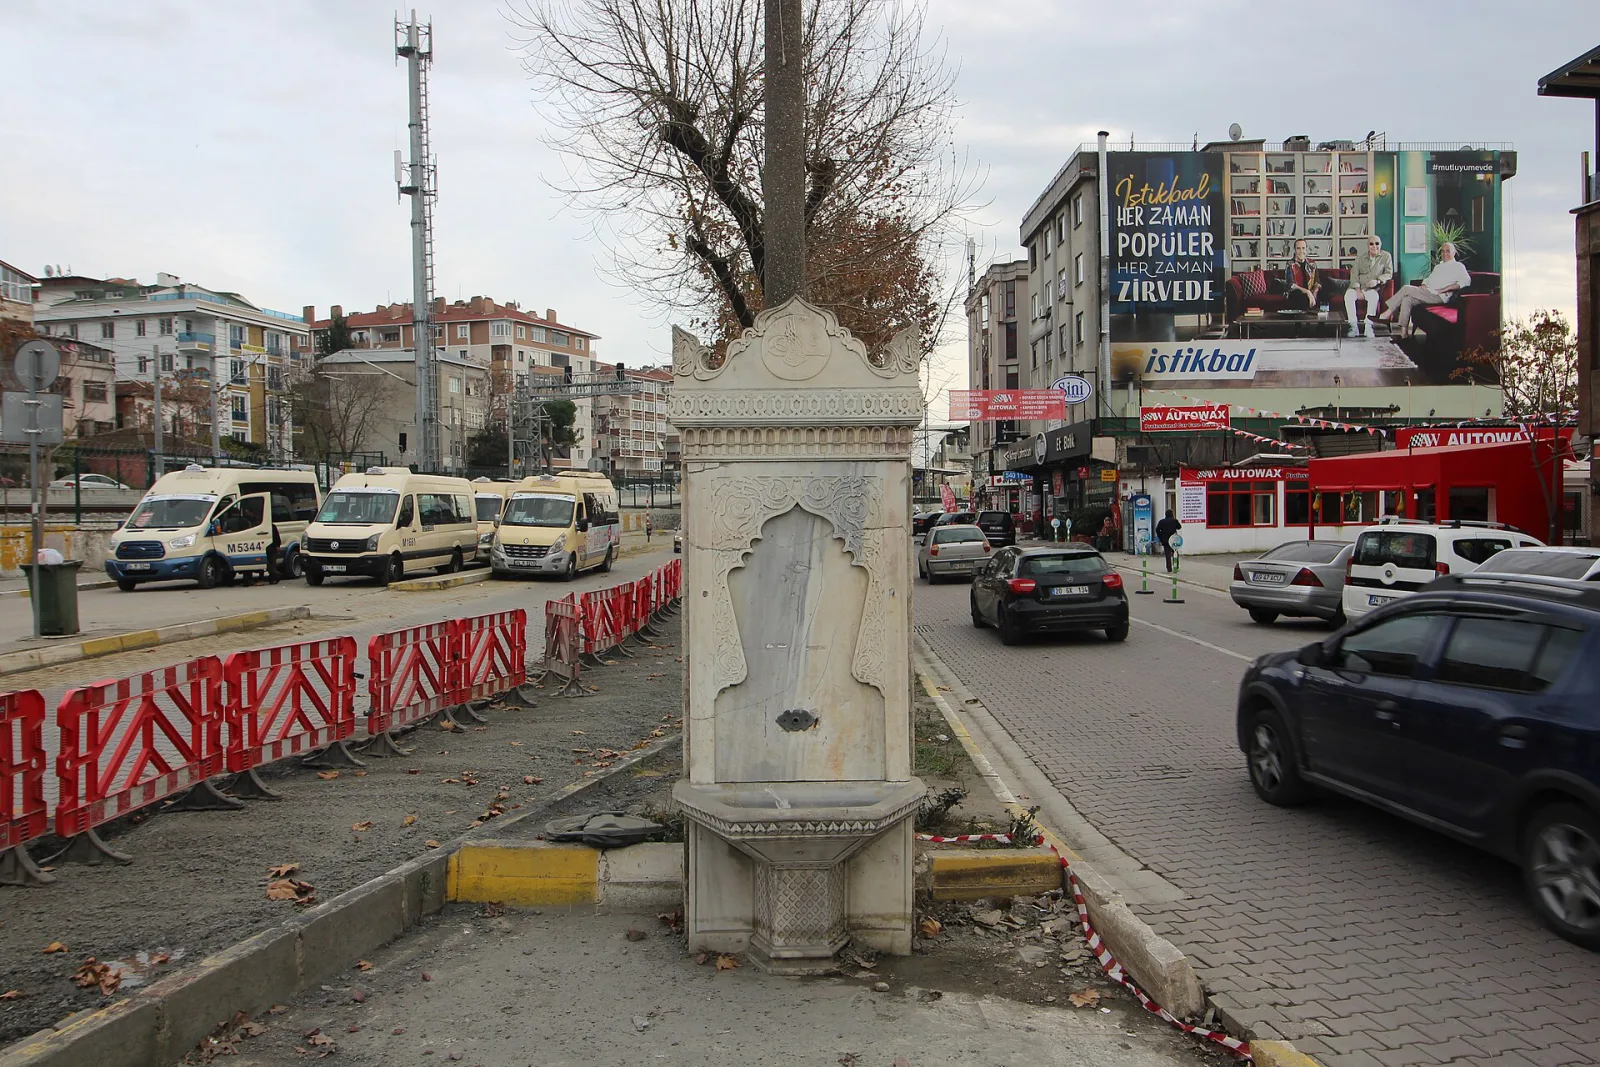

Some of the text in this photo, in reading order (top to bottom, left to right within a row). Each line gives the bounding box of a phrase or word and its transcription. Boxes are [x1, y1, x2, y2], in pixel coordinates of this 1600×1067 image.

[1432, 164, 1493, 172] #mutluyumevde
[1115, 173, 1210, 209] İstikbal
[1117, 205, 1211, 227] HER ZAMAN
[1117, 232, 1214, 257] POPÜLER
[1117, 261, 1213, 278] HER ZAMAN
[1117, 278, 1215, 303] ZİRVEDE
[1145, 348, 1256, 373] istikbal
[1058, 381, 1084, 397] Sini
[1166, 410, 1226, 421] AUTOWAX
[1222, 469, 1282, 479] AUTOWAX
[227, 542, 262, 553] M 5344
